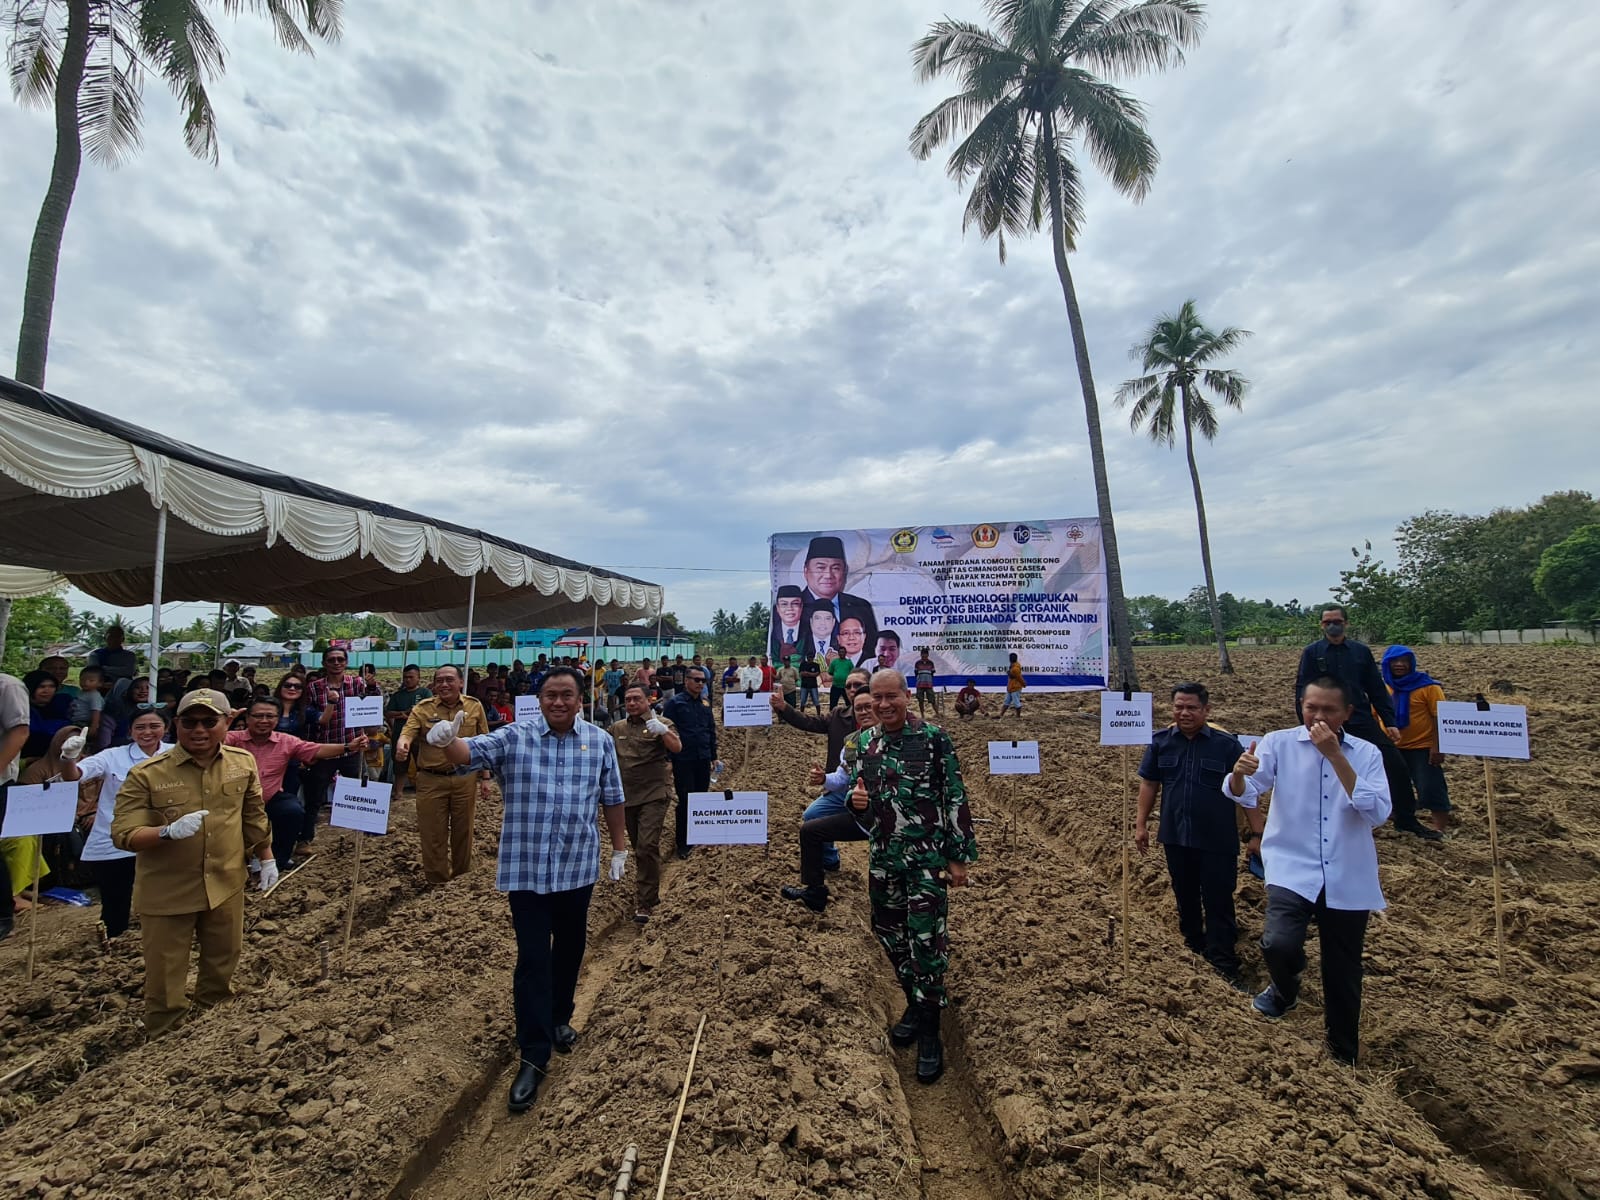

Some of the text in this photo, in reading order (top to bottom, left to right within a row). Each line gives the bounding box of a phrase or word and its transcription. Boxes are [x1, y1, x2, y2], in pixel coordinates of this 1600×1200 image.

[899, 593, 1078, 605] DEMPLOT TEKNOLOGI PEMUPUKAN
[908, 603, 1070, 615] SINGKONG BERBASIS ORGANIK
[884, 616, 928, 625] PRODUK
[1021, 614, 1098, 623] CITRAMANDIRI
[1442, 719, 1491, 727] KOMANDAN
[155, 781, 184, 790] HAMKA
[344, 795, 377, 805] GUBERNUR
[357, 806, 385, 814] GORONTALO
